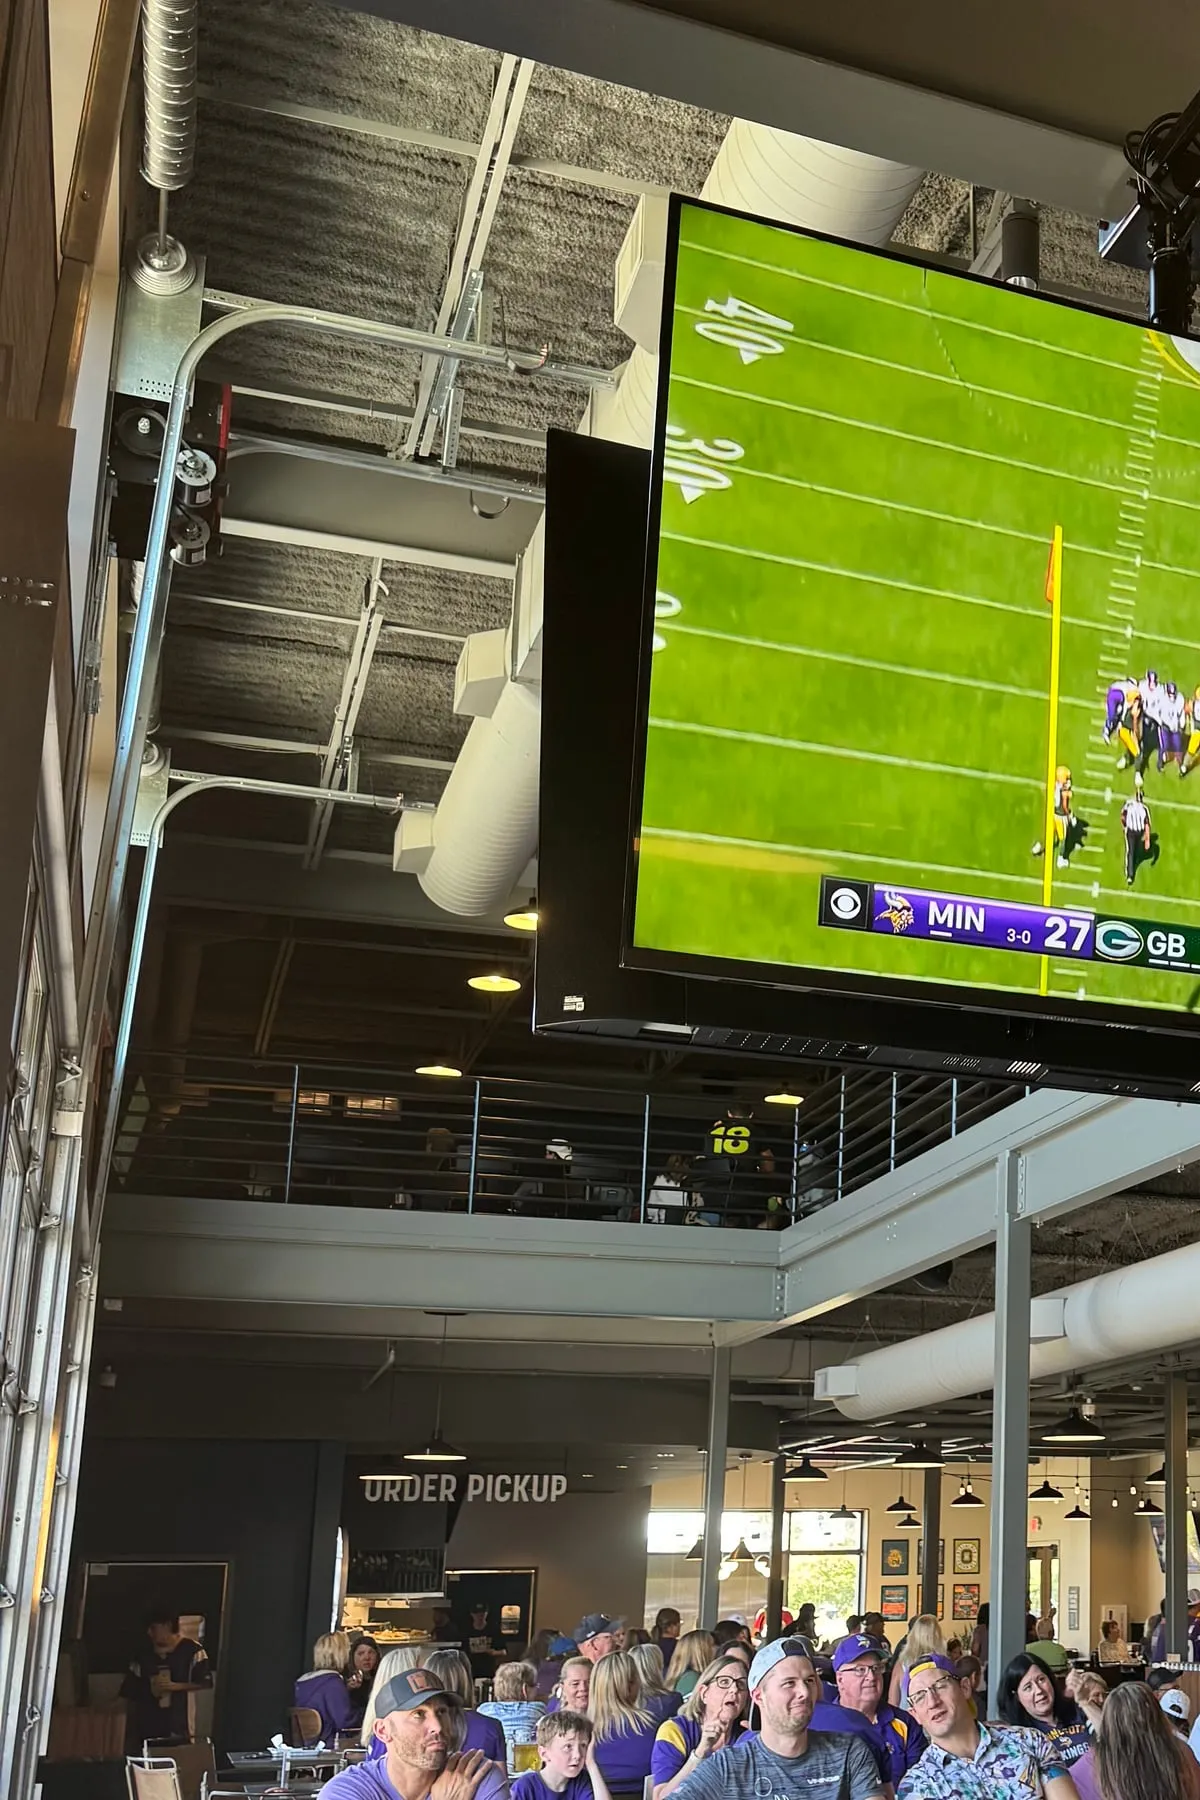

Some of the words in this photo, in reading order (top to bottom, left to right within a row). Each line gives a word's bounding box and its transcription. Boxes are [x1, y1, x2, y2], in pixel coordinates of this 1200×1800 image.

[927, 901, 986, 932] MIN
[1006, 928, 1031, 945] 3-0
[1044, 916, 1091, 951] 27
[1146, 930, 1186, 958] GB
[364, 1473, 457, 1503] ORDER
[466, 1474, 568, 1504] PICKUP
